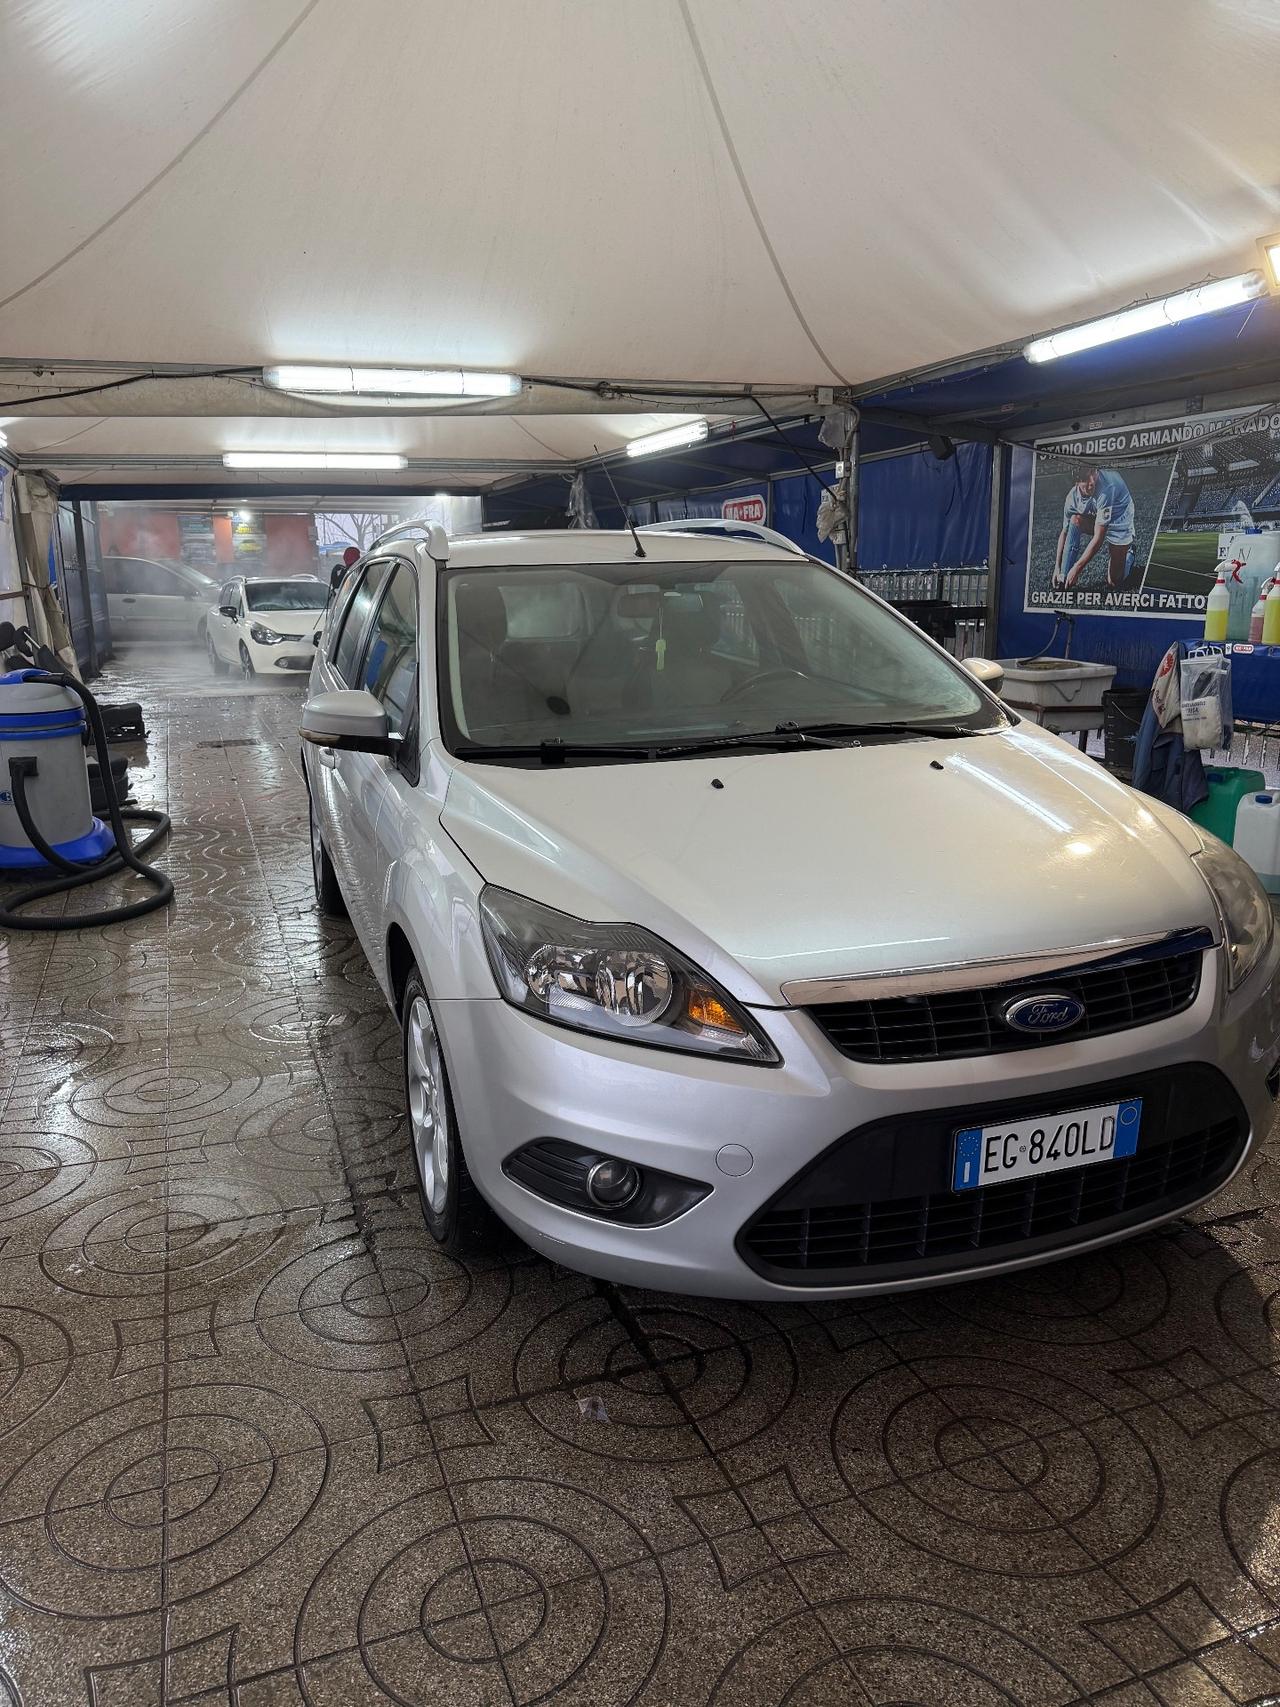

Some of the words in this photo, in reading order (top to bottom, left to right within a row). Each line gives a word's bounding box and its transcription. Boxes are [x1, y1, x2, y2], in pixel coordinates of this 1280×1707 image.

[1086, 436, 1125, 454] DIEGO
[1130, 424, 1204, 447] ARMANDO
[1032, 591, 1073, 604] GRAZIE
[1077, 592, 1101, 606] PER
[1105, 593, 1154, 608] AVERCI
[1159, 594, 1206, 609] FATTO
[1028, 1003, 1069, 1024] Ford
